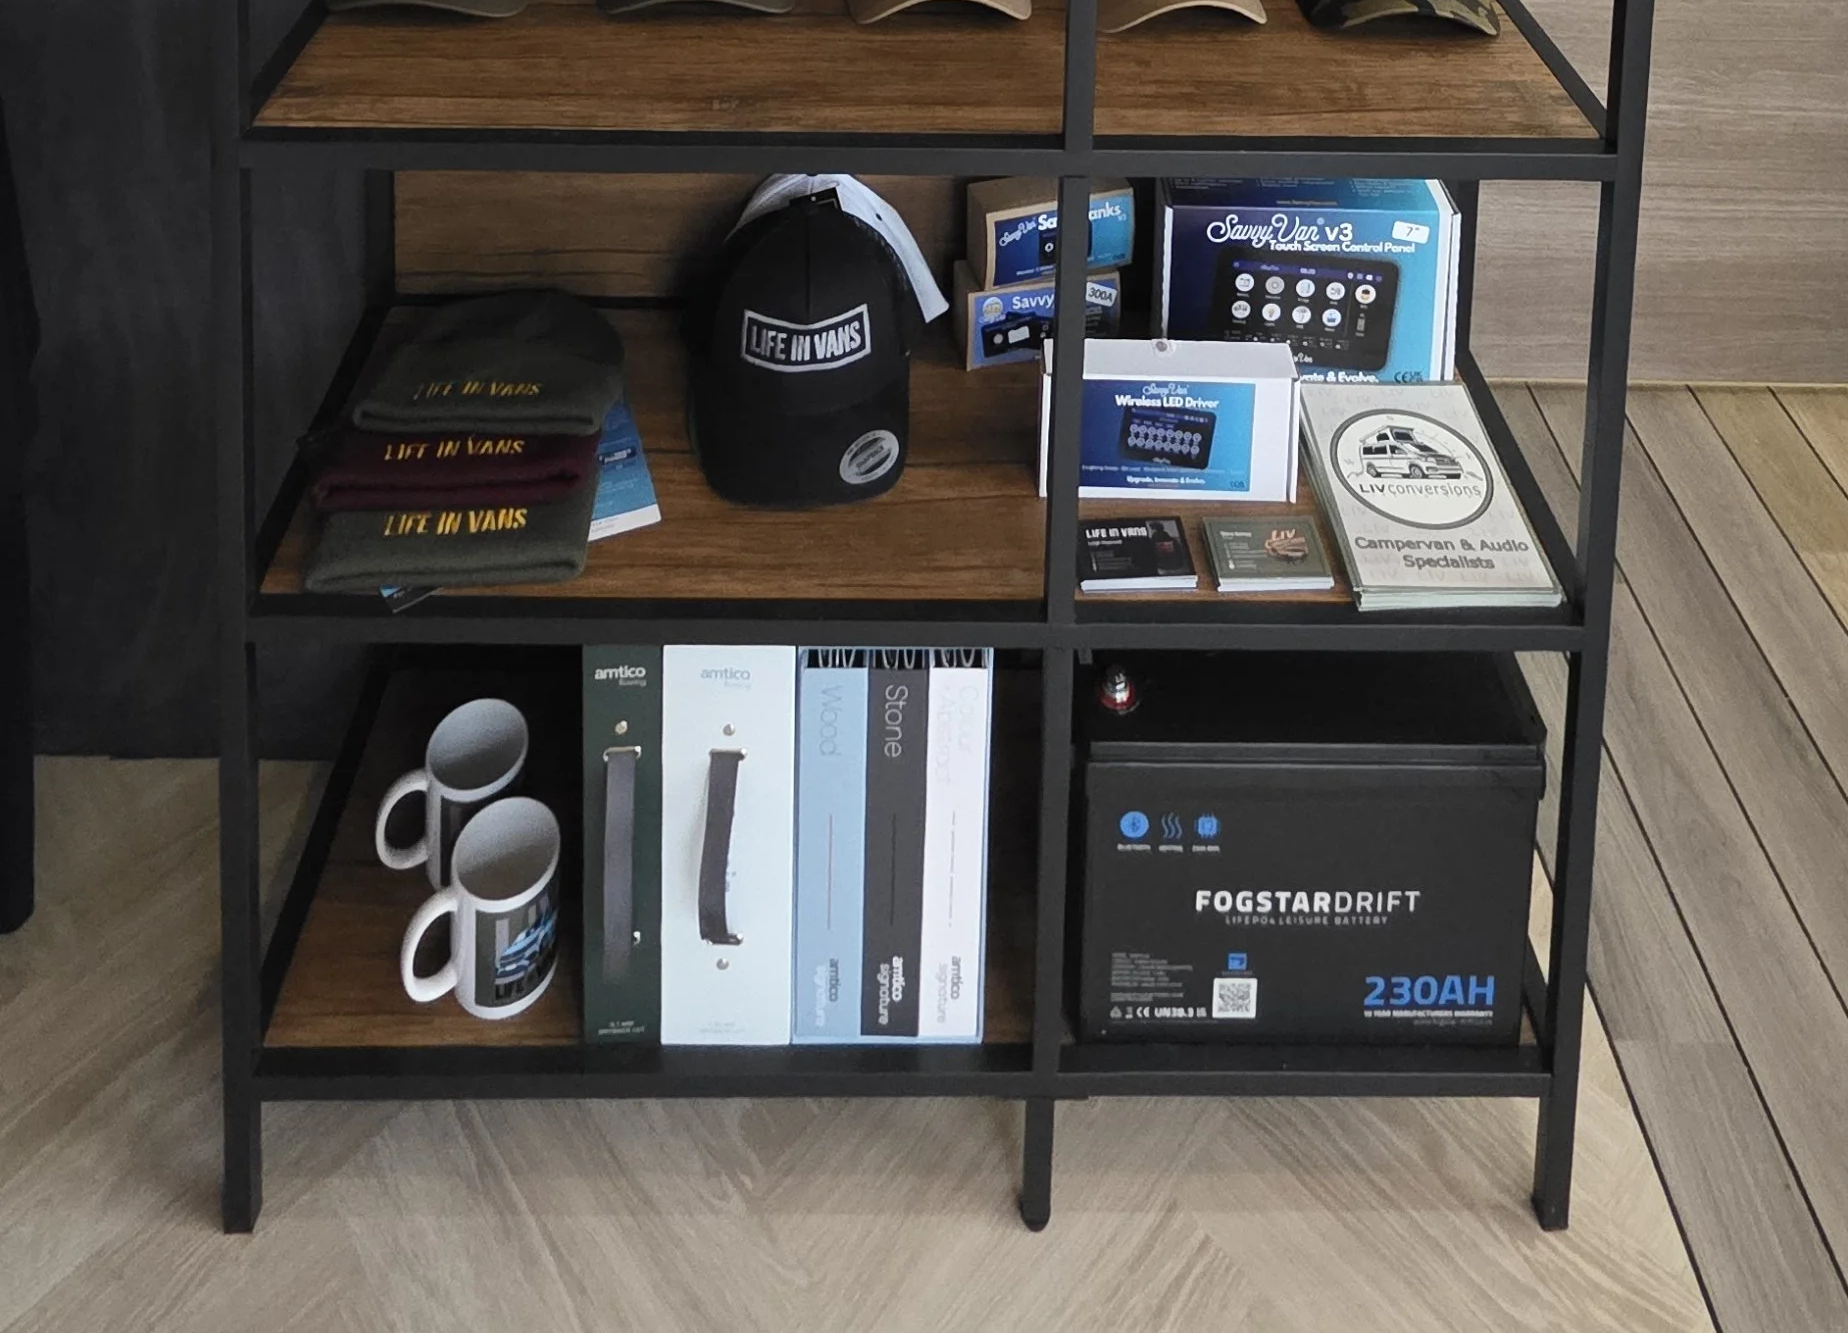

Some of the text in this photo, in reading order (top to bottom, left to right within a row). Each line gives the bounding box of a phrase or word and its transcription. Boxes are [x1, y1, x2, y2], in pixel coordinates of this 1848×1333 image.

[1088, 202, 1121, 221] anks
[1325, 222, 1353, 241] v3
[1270, 240, 1415, 253] Touch Screen Control Panel
[1088, 287, 1112, 302] 300A
[751, 320, 861, 361] LIFE IN VANS
[1300, 371, 1379, 383] vate & Evolve.
[462, 381, 484, 394] IN
[490, 381, 542, 396] VANS
[1115, 395, 1220, 409] Wireless LED Driver
[436, 440, 460, 458] IN
[467, 437, 525, 455] VANS
[1359, 482, 1481, 498] LIV conversions
[384, 508, 528, 536] LIFE IN VANS
[1086, 527, 1147, 539] LIFE IN VANS
[1271, 529, 1296, 541] LIV
[1355, 536, 1529, 552] Campervan & Audio
[1403, 555, 1495, 569] Specialists
[594, 665, 646, 680] amtico
[701, 666, 751, 681] amtico
[819, 685, 843, 757] Wood
[884, 685, 909, 758] Stone
[1334, 916, 1388, 925] BATTERY
[829, 958, 842, 1002] amtico
[892, 956, 906, 1002] amtico
[950, 956, 963, 1000] amtico
[877, 963, 891, 1025] signature
[1363, 975, 1495, 1006] 230AH
